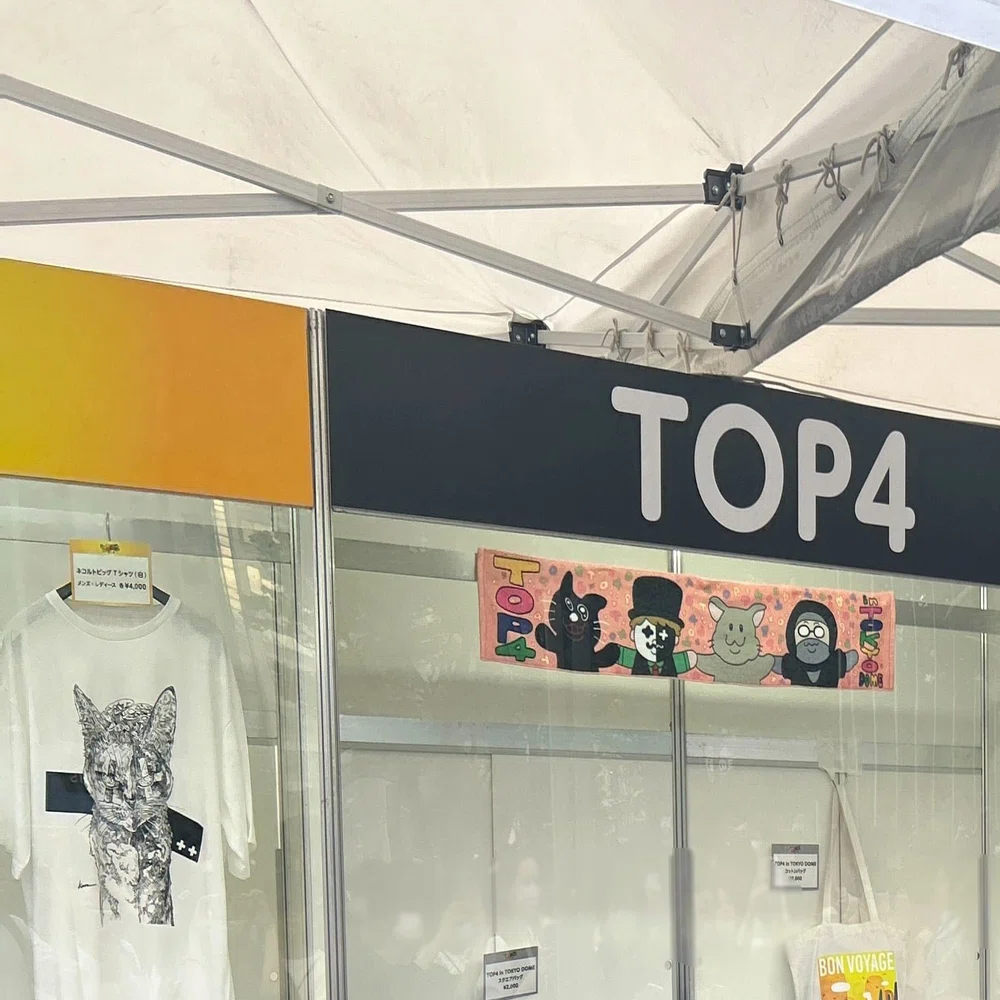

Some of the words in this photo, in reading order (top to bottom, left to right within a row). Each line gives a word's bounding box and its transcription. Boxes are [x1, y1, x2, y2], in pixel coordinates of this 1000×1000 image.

[610, 385, 916, 553] TOP4
[493, 555, 541, 662] TOP4
[859, 606, 884, 673] TOKYO
[818, 956, 846, 977] BON
[846, 951, 895, 974] VOYAGE
